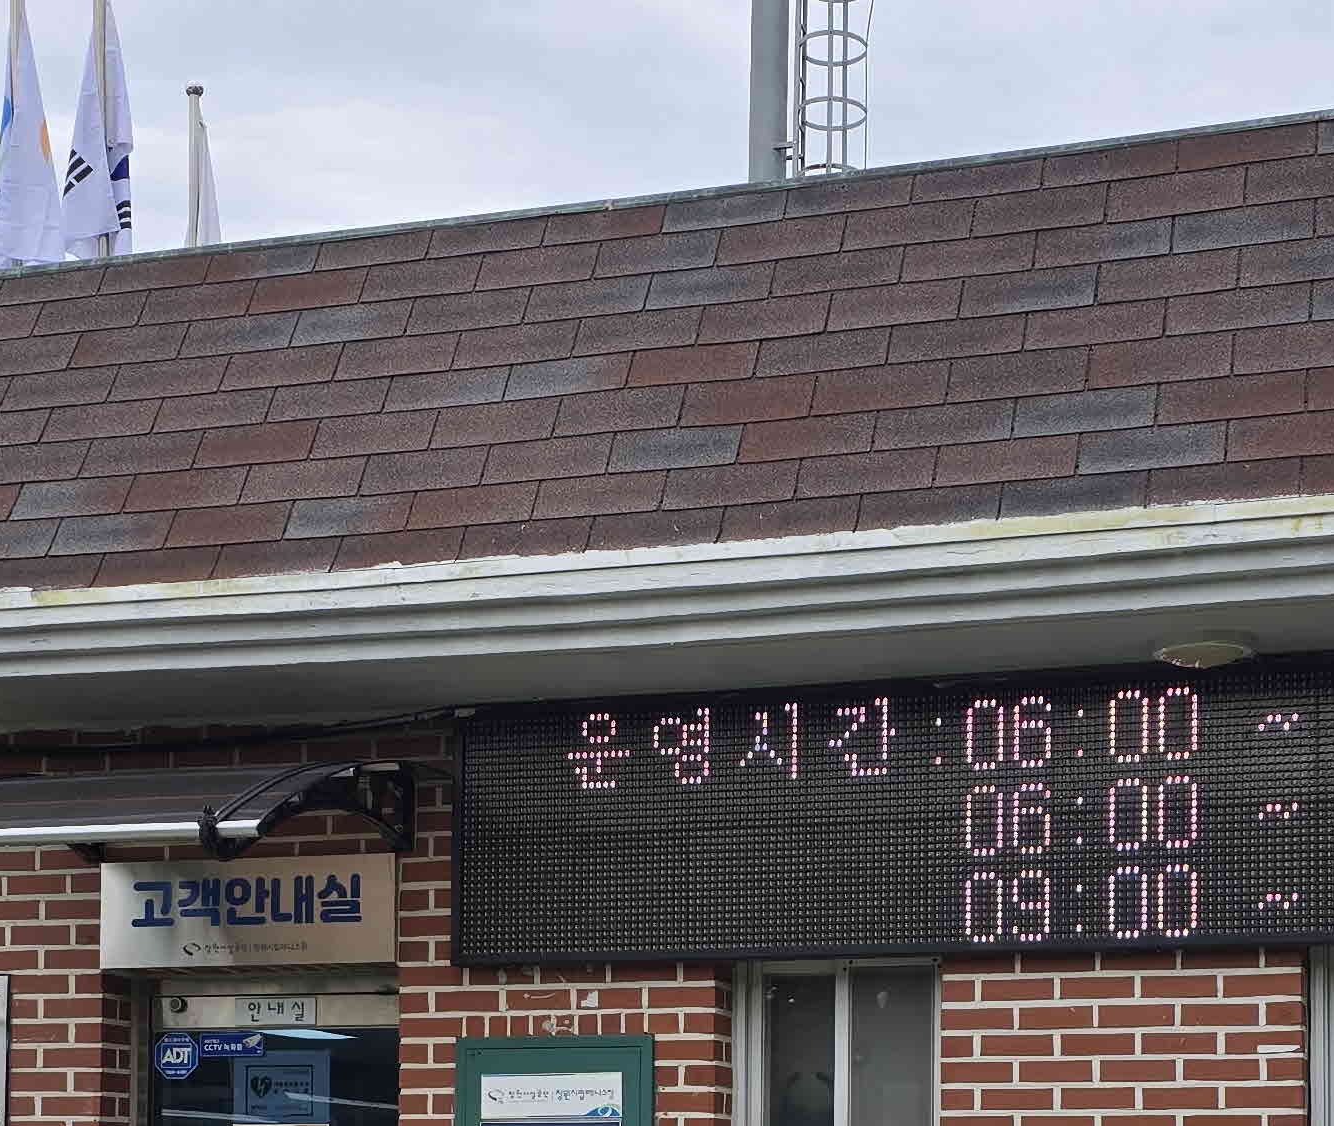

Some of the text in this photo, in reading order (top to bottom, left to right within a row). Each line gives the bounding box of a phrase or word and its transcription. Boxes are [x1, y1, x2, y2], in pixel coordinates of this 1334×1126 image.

[966, 774, 1198, 857] 06:00
[131, 872, 362, 929] 고객안내실
[965, 863, 1198, 944] 09:00
[162, 1047, 193, 1064] ADT
[203, 1043, 223, 1052] CCTV
